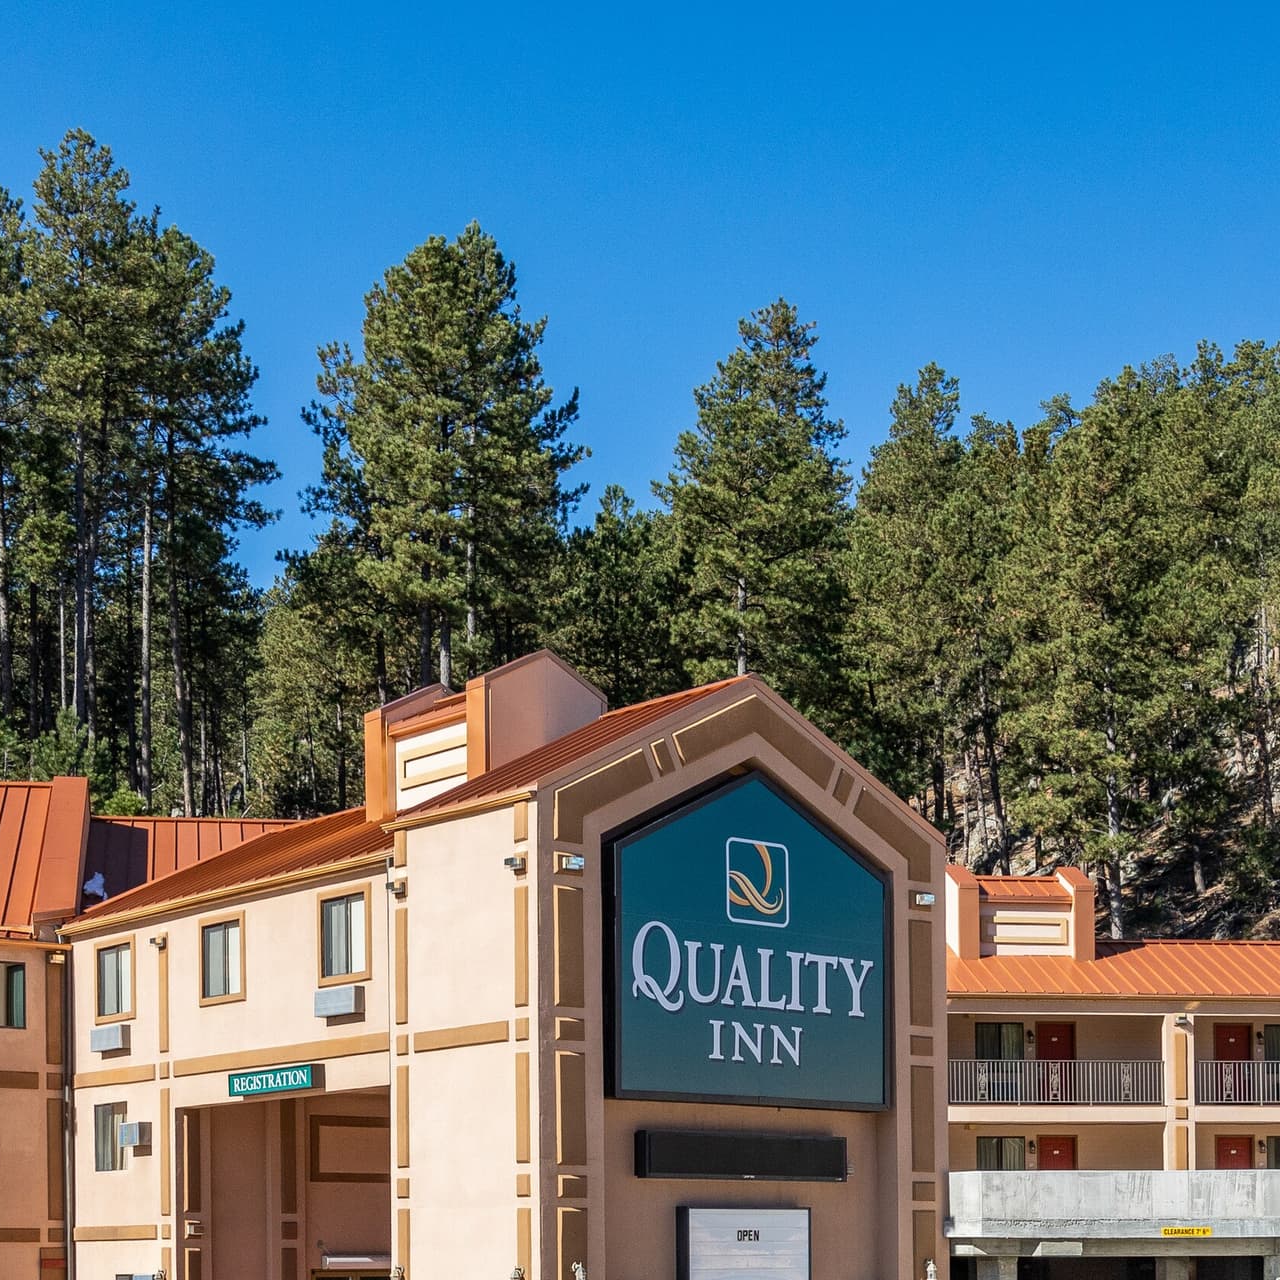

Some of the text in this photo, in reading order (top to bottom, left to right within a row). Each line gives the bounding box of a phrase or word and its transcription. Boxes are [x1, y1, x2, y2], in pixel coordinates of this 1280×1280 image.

[632, 921, 874, 1018] QUALITY
[708, 1020, 804, 1067] INN
[233, 1069, 308, 1093] REGISTRATION
[736, 1229, 760, 1242] OPEN
